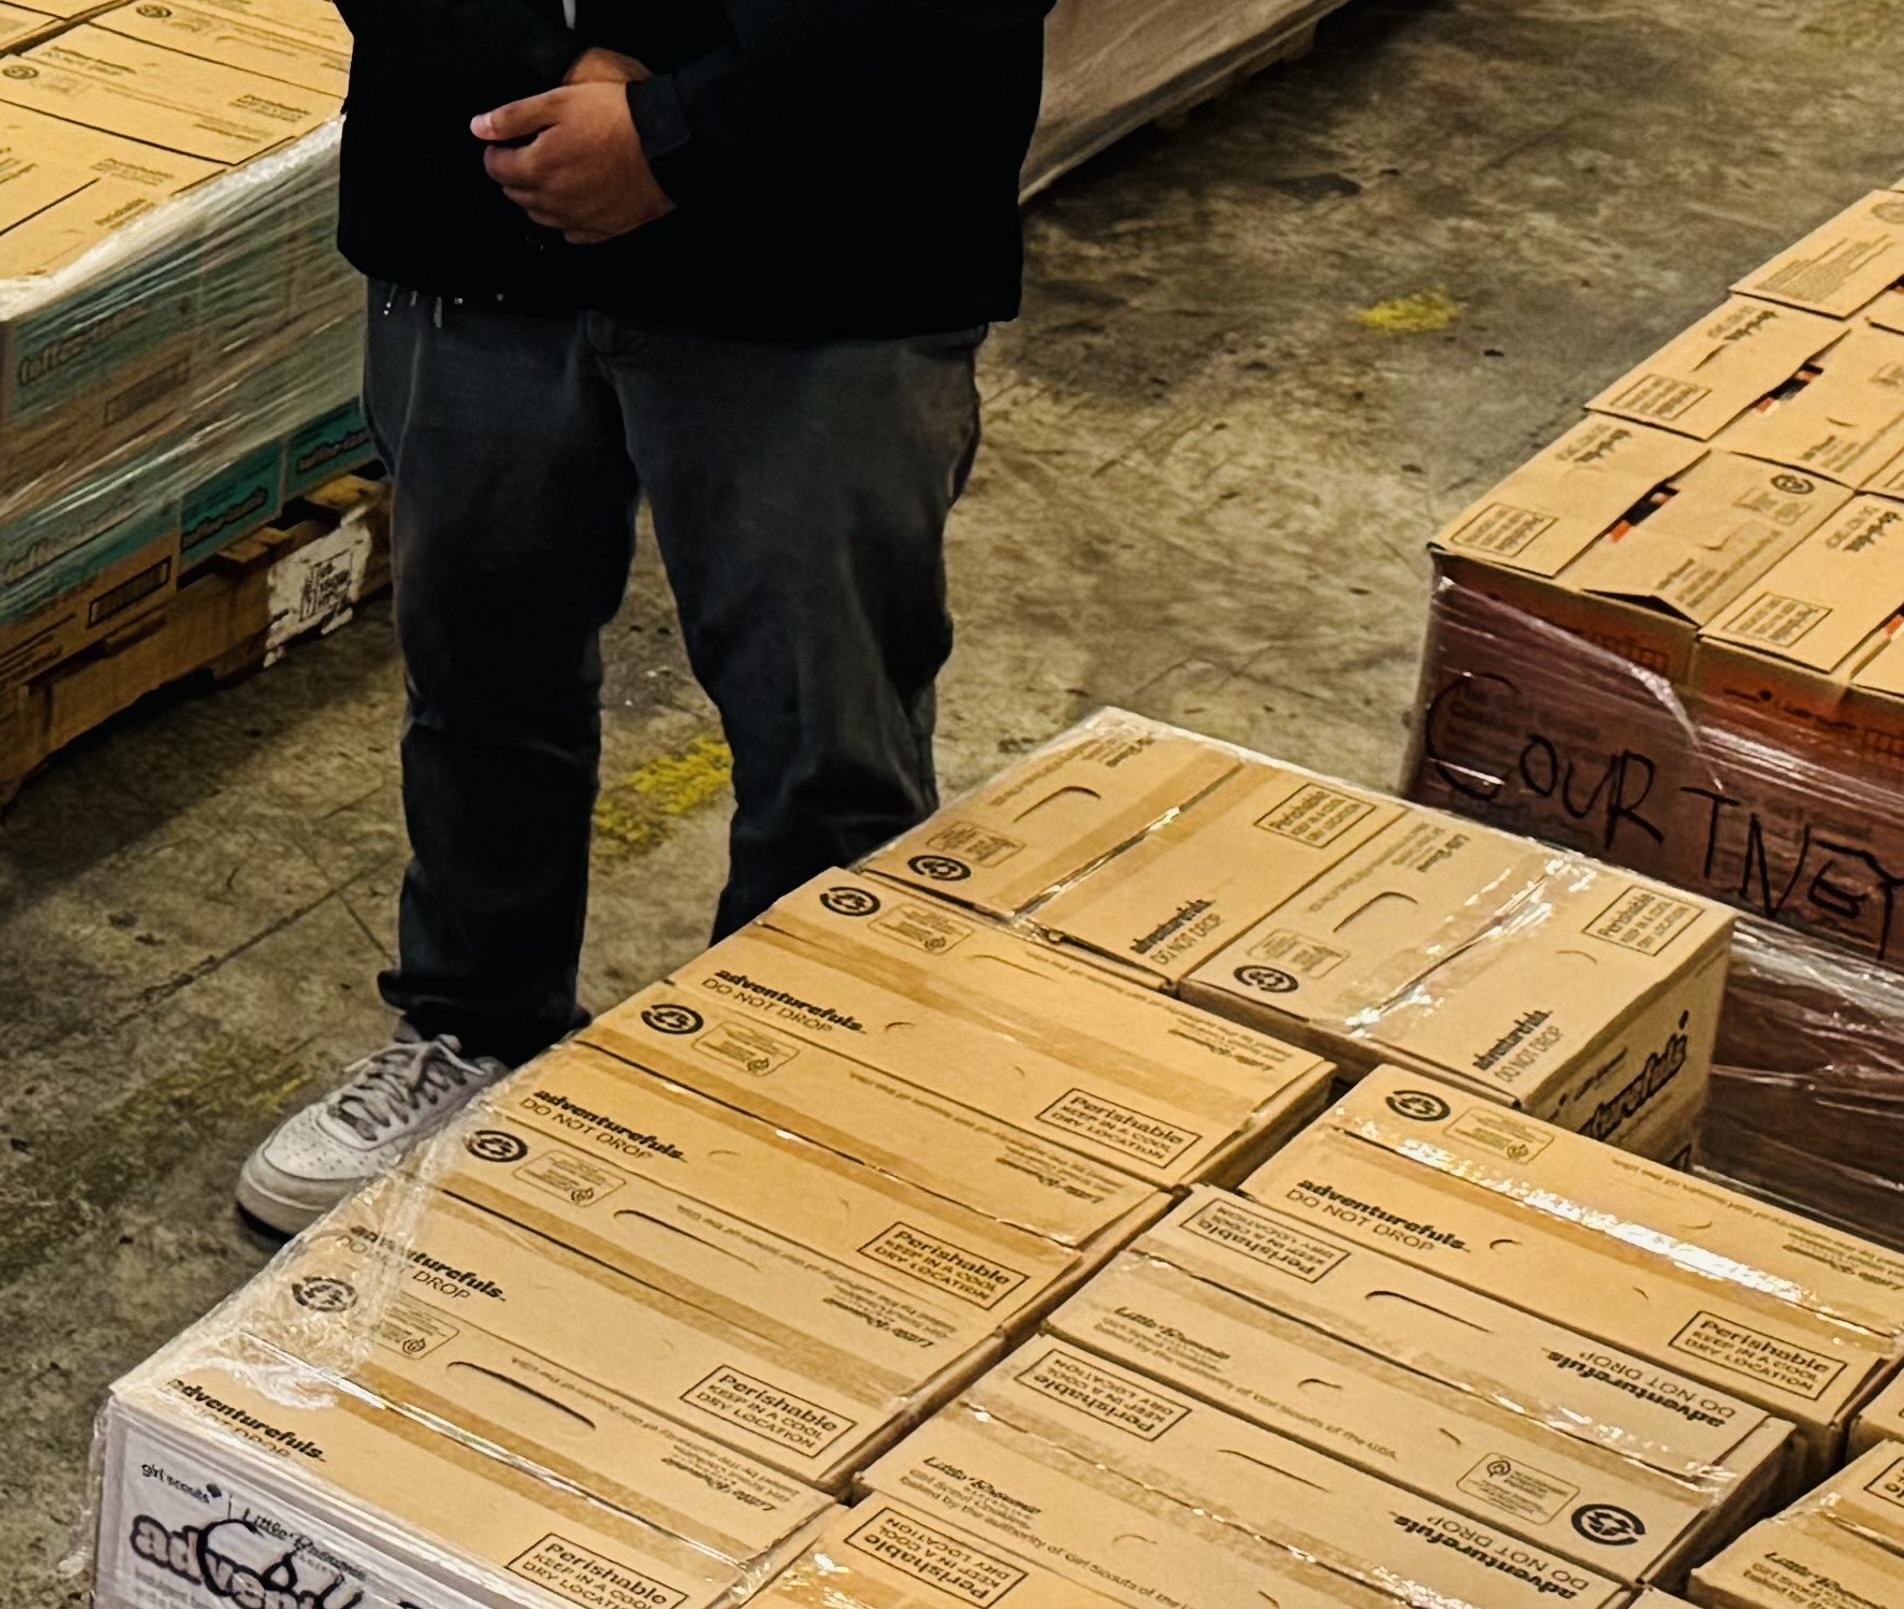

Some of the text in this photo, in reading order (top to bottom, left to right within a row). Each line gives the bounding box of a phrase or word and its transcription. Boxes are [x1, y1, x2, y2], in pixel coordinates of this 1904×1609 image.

[1425, 673, 1904, 960] COURTNEY
[714, 969, 867, 1034] adventurefuls
[518, 1097, 654, 1162] DO NOT DROP
[533, 1090, 688, 1164] adventurefuls
[1296, 1179, 1469, 1253] adventurefuls
[893, 1230, 1011, 1285] Perishable
[1699, 1318, 1830, 1374] Perishable
[717, 1373, 838, 1434] Perishable
